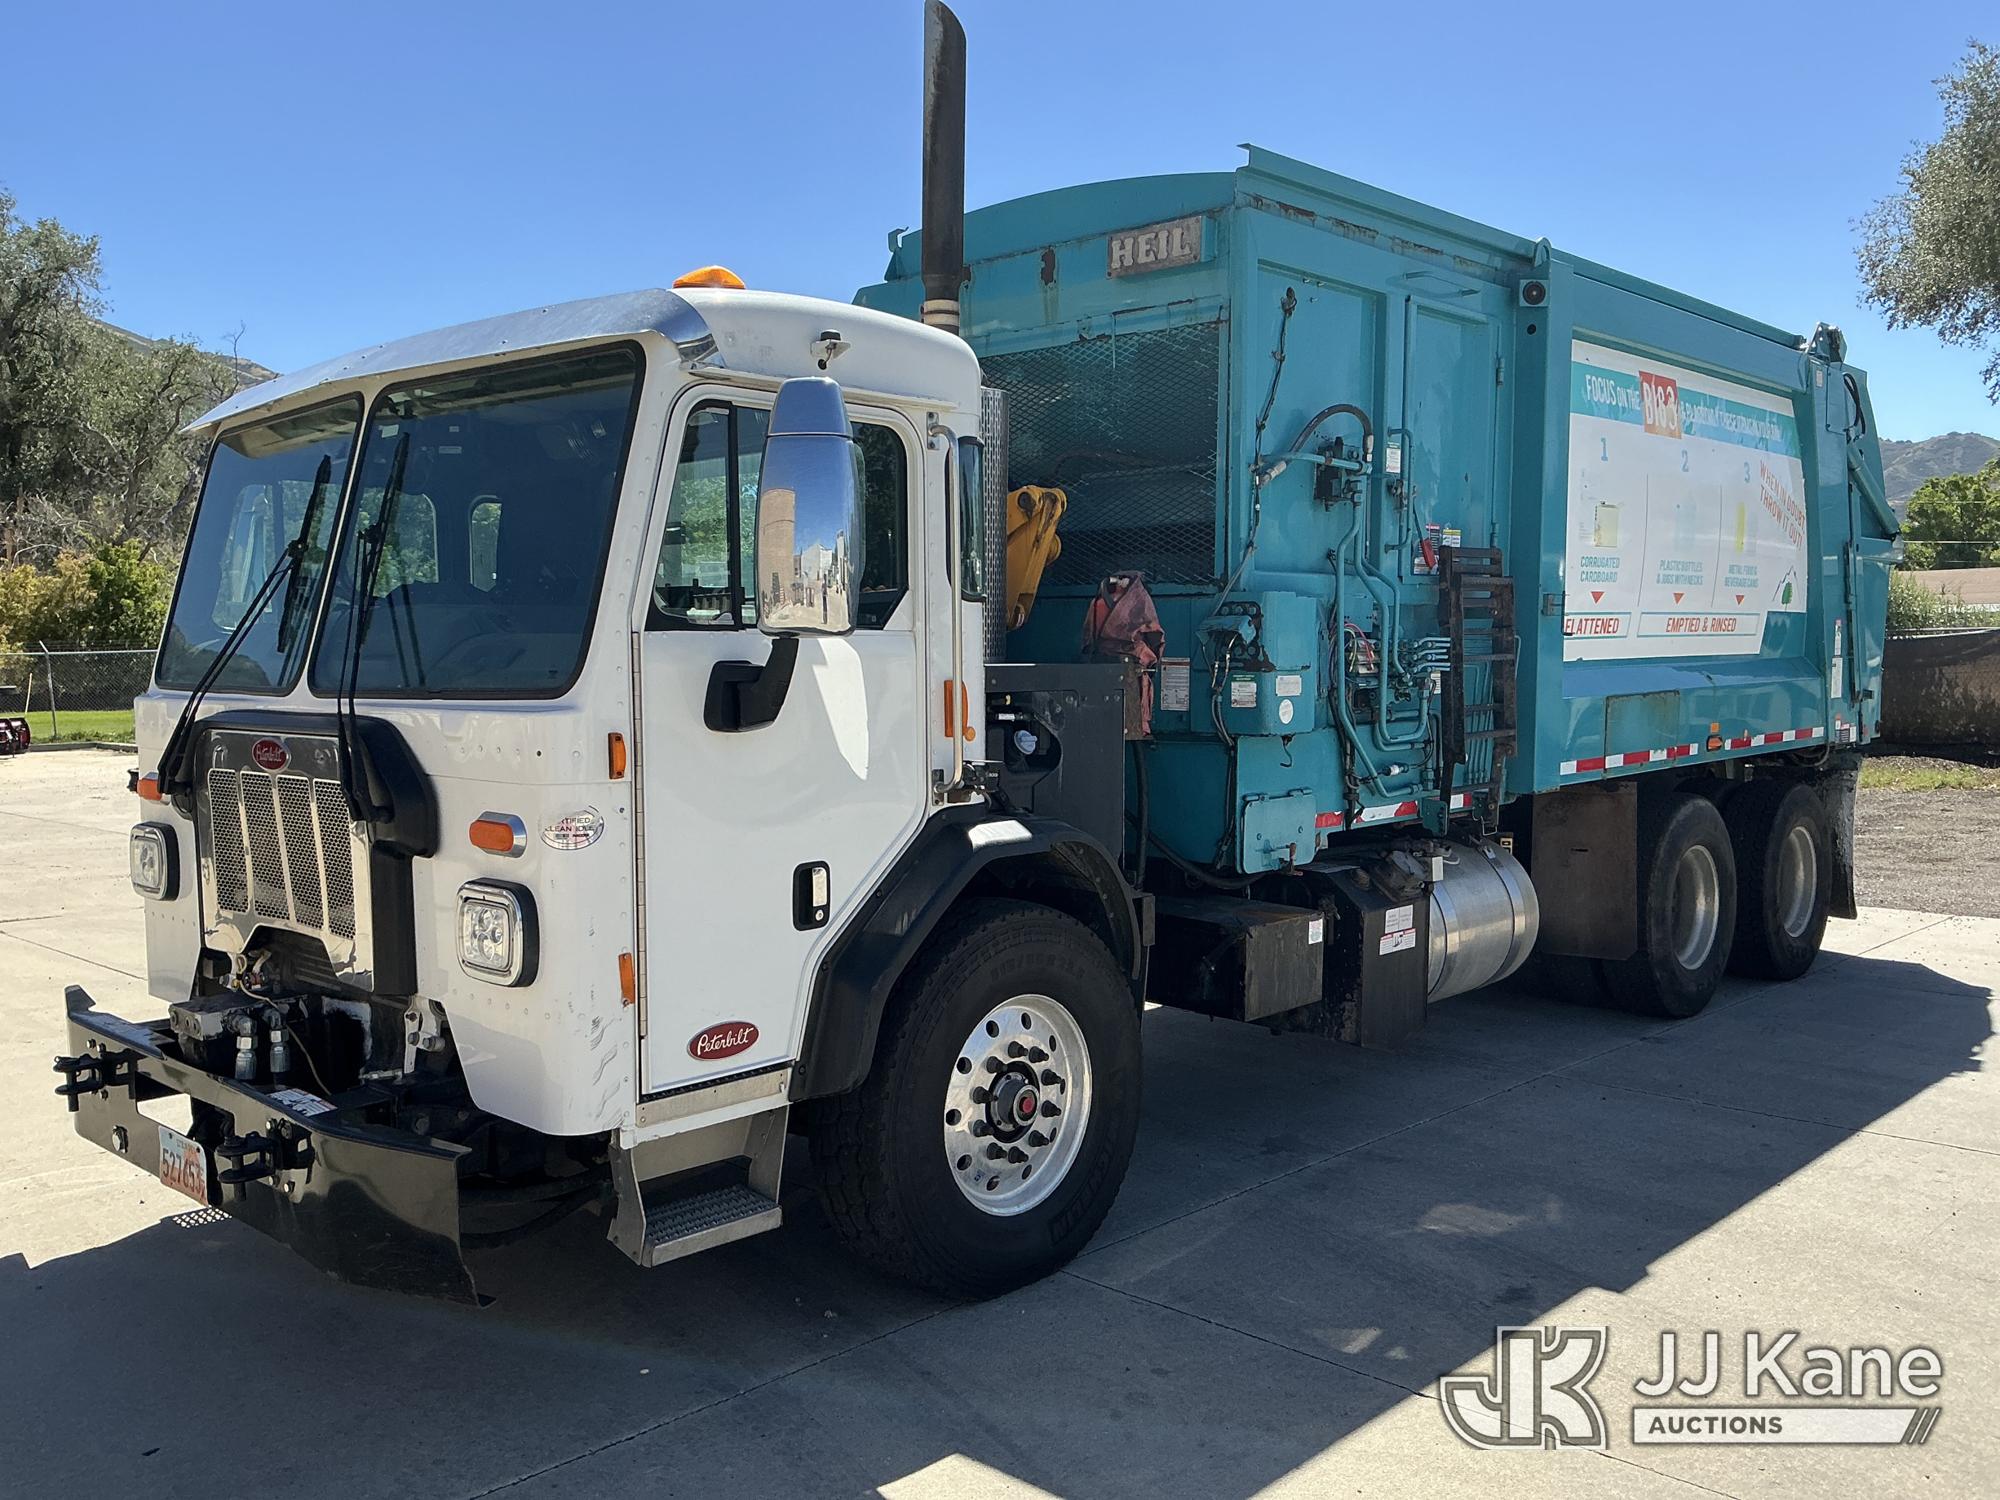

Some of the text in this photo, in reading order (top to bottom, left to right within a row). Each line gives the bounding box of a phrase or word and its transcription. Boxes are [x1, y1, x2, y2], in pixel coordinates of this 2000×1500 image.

[1111, 227, 1192, 270] HEIL
[1585, 374, 1616, 405] FOCUS
[1600, 438, 1609, 461] 1
[1681, 450, 1689, 473] 2
[1743, 461, 1751, 483] 3
[1760, 483, 1781, 524] THROW
[1580, 556, 1620, 569] CORRUGATED
[1580, 571, 1618, 583] CARDBOARD
[1665, 616, 1737, 633] EMPTIED & RINSED
[697, 1027, 754, 1056] Peterbilt
